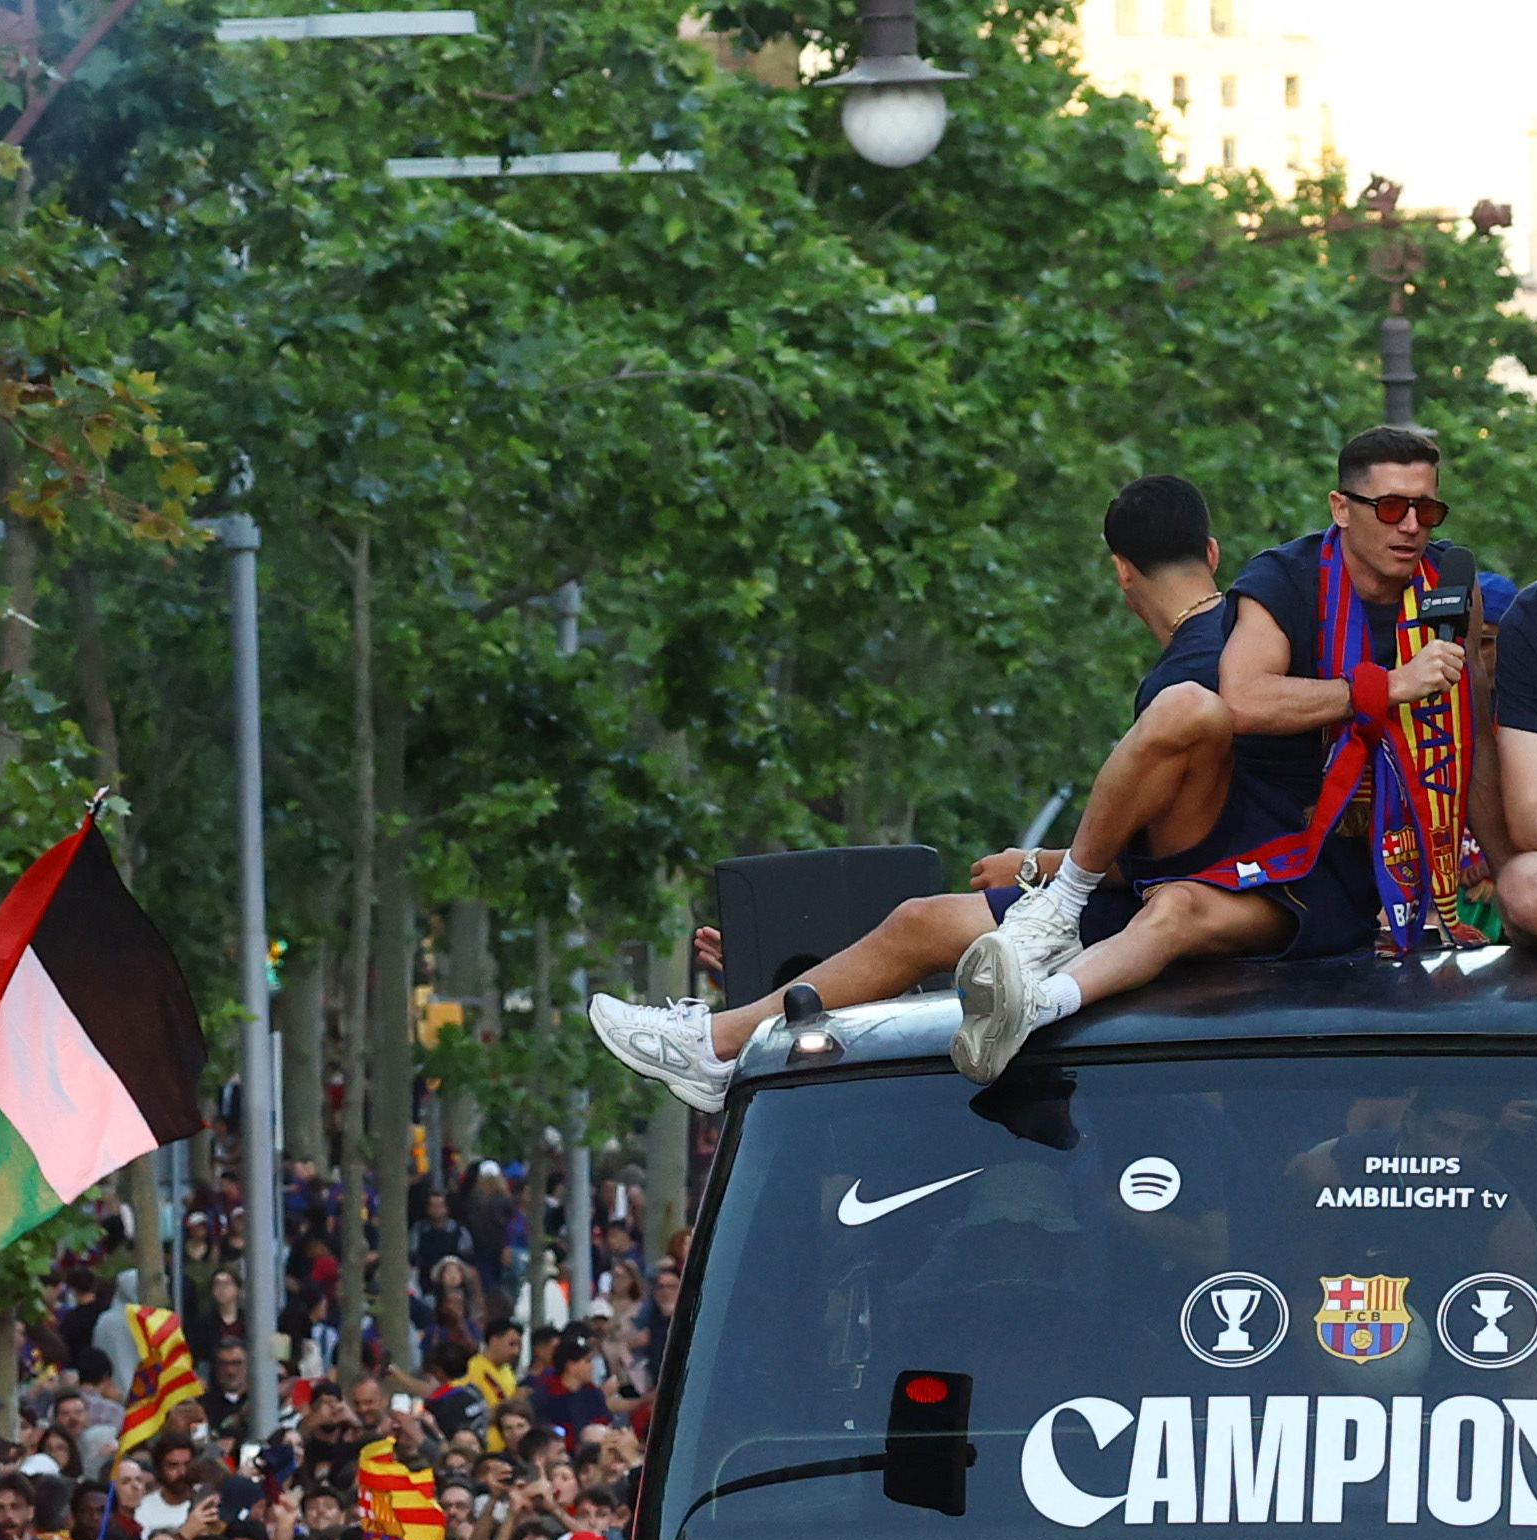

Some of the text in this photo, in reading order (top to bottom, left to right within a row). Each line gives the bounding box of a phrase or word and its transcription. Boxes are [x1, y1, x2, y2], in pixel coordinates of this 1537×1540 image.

[1365, 1156, 1461, 1175] PHILIPS
[1314, 1186, 1509, 1209] AMBILIGHT tv
